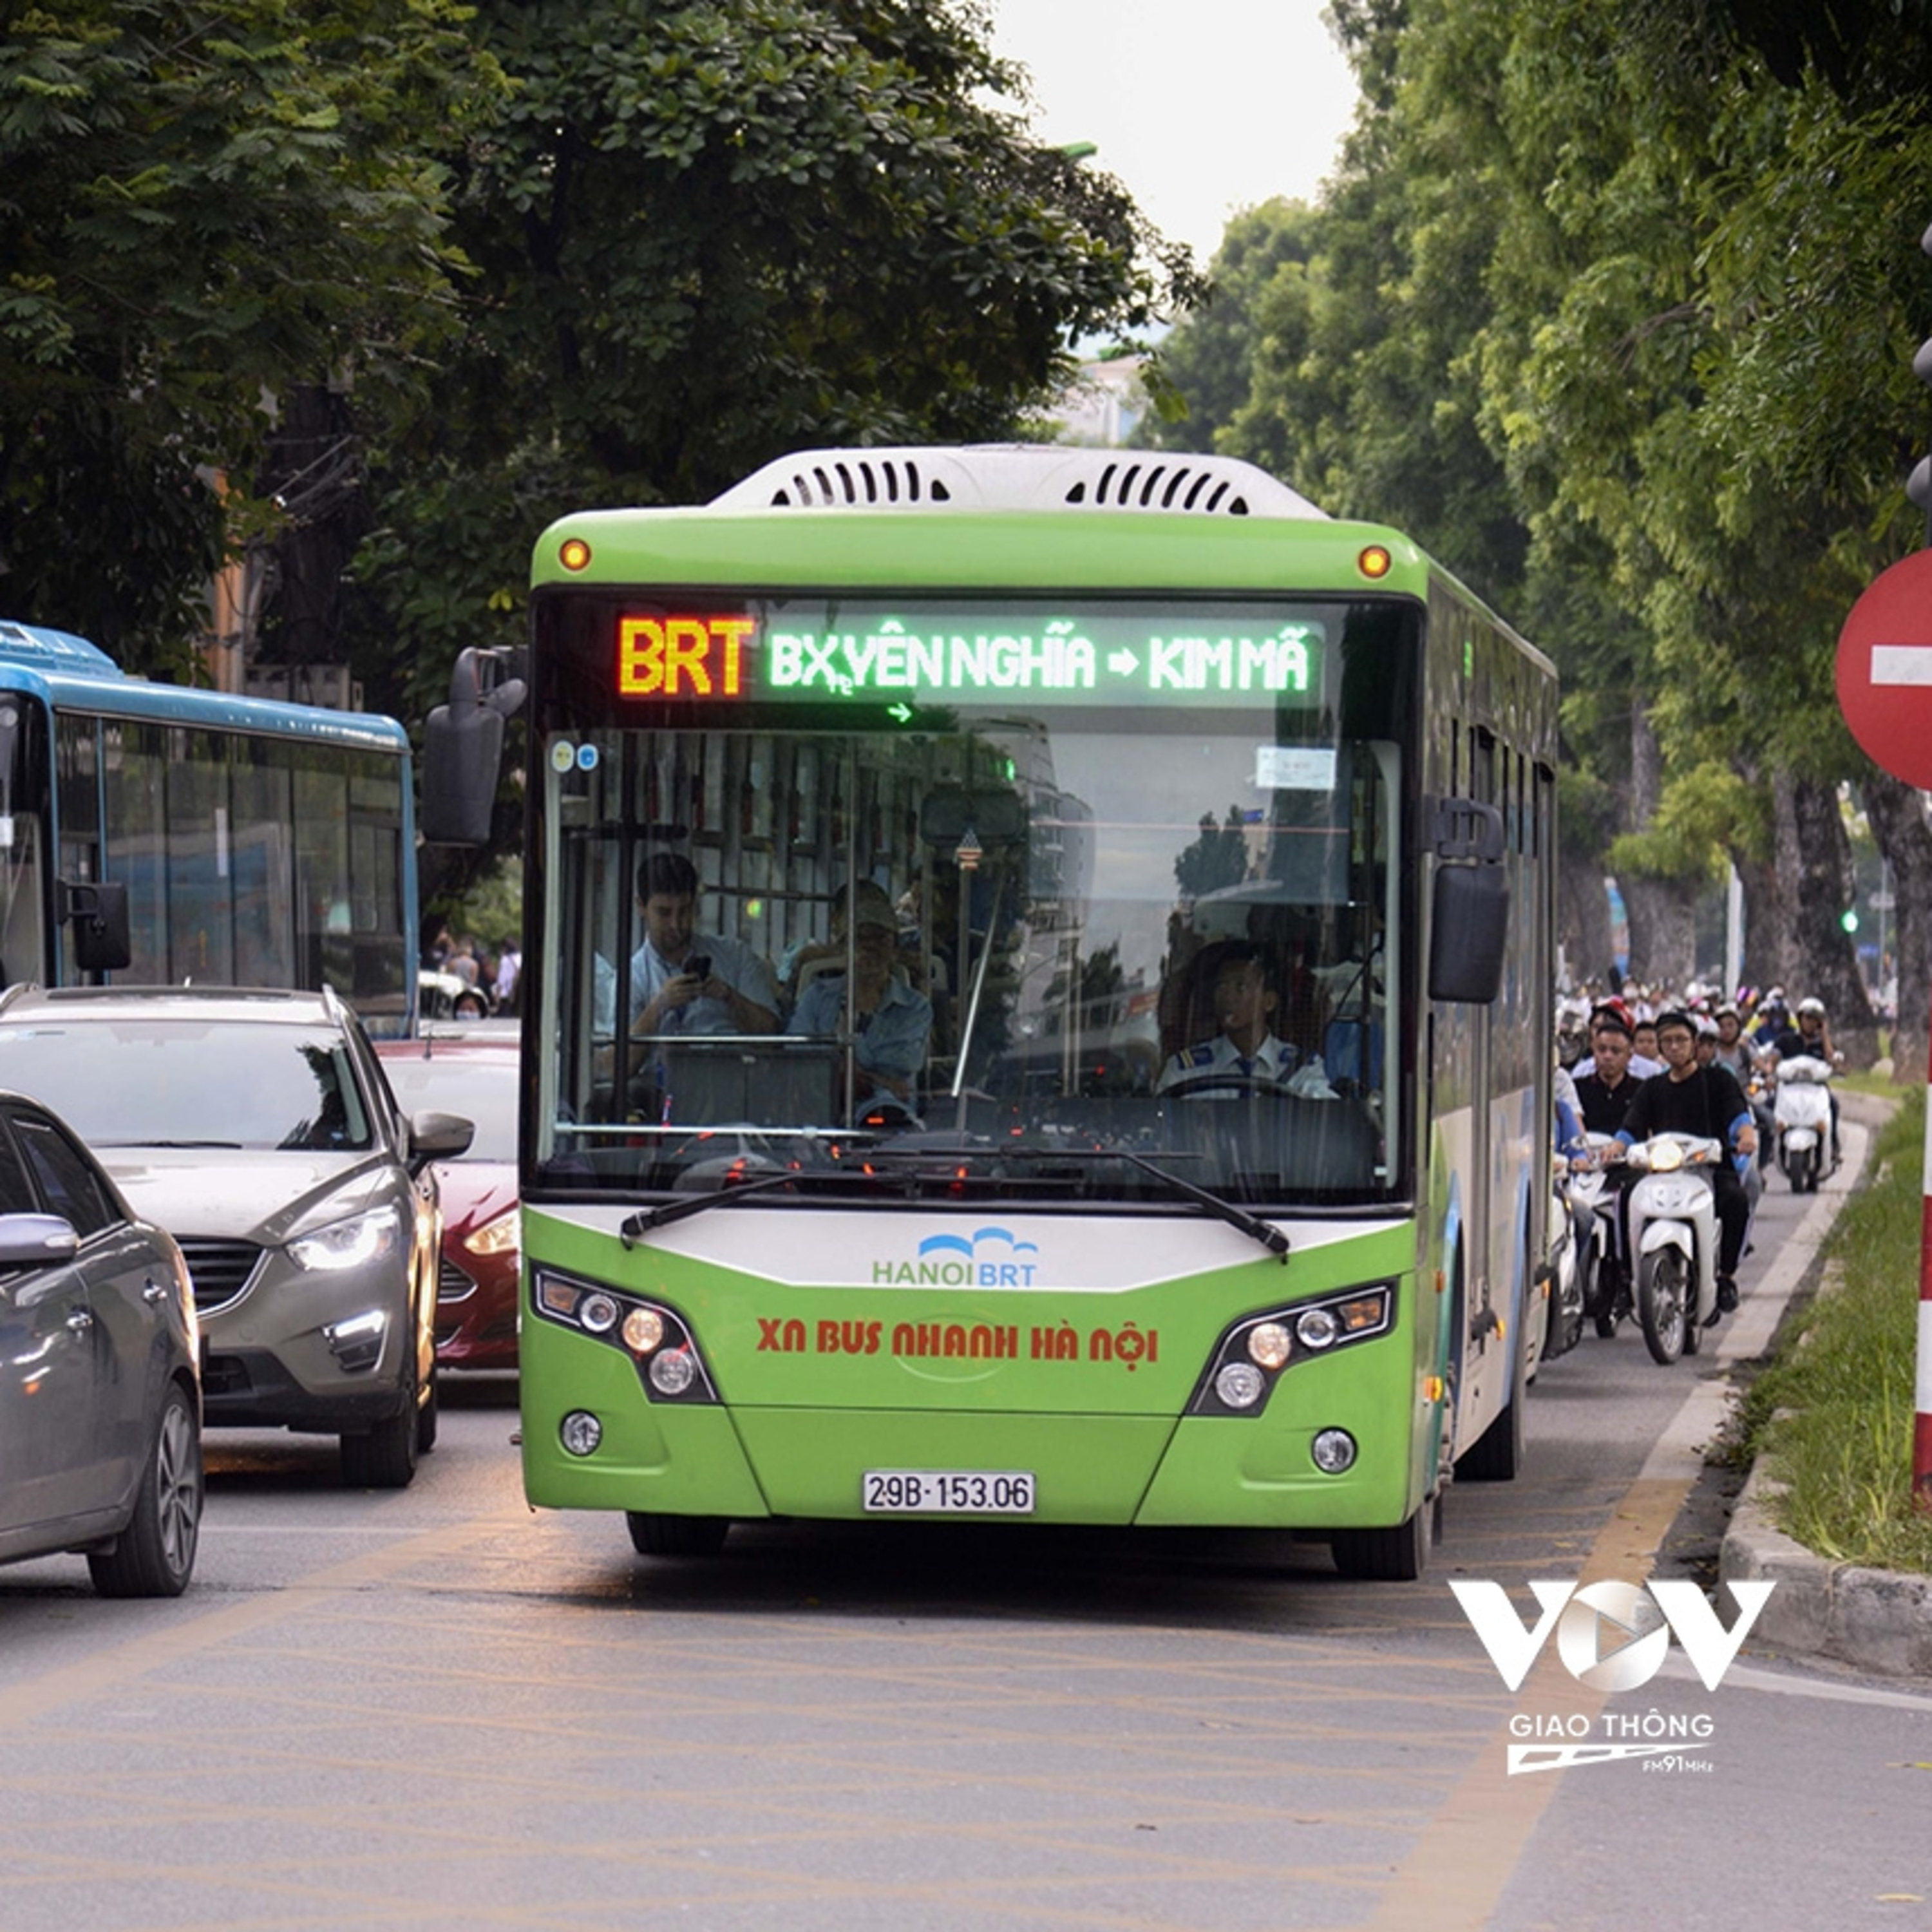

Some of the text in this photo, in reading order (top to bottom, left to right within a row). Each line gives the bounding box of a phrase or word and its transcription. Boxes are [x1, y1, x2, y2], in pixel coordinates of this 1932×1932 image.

[618, 616, 755, 696] BRT
[771, 620, 1309, 690] BX YÊN NGHĨA KIM MÃ
[817, 1320, 882, 1355] BUS
[891, 1323, 1018, 1359] NHANH
[1030, 1319, 1078, 1360] HÀ
[1089, 1321, 1159, 1372] NỘI
[867, 1476, 1030, 1508] 29B-153.06
